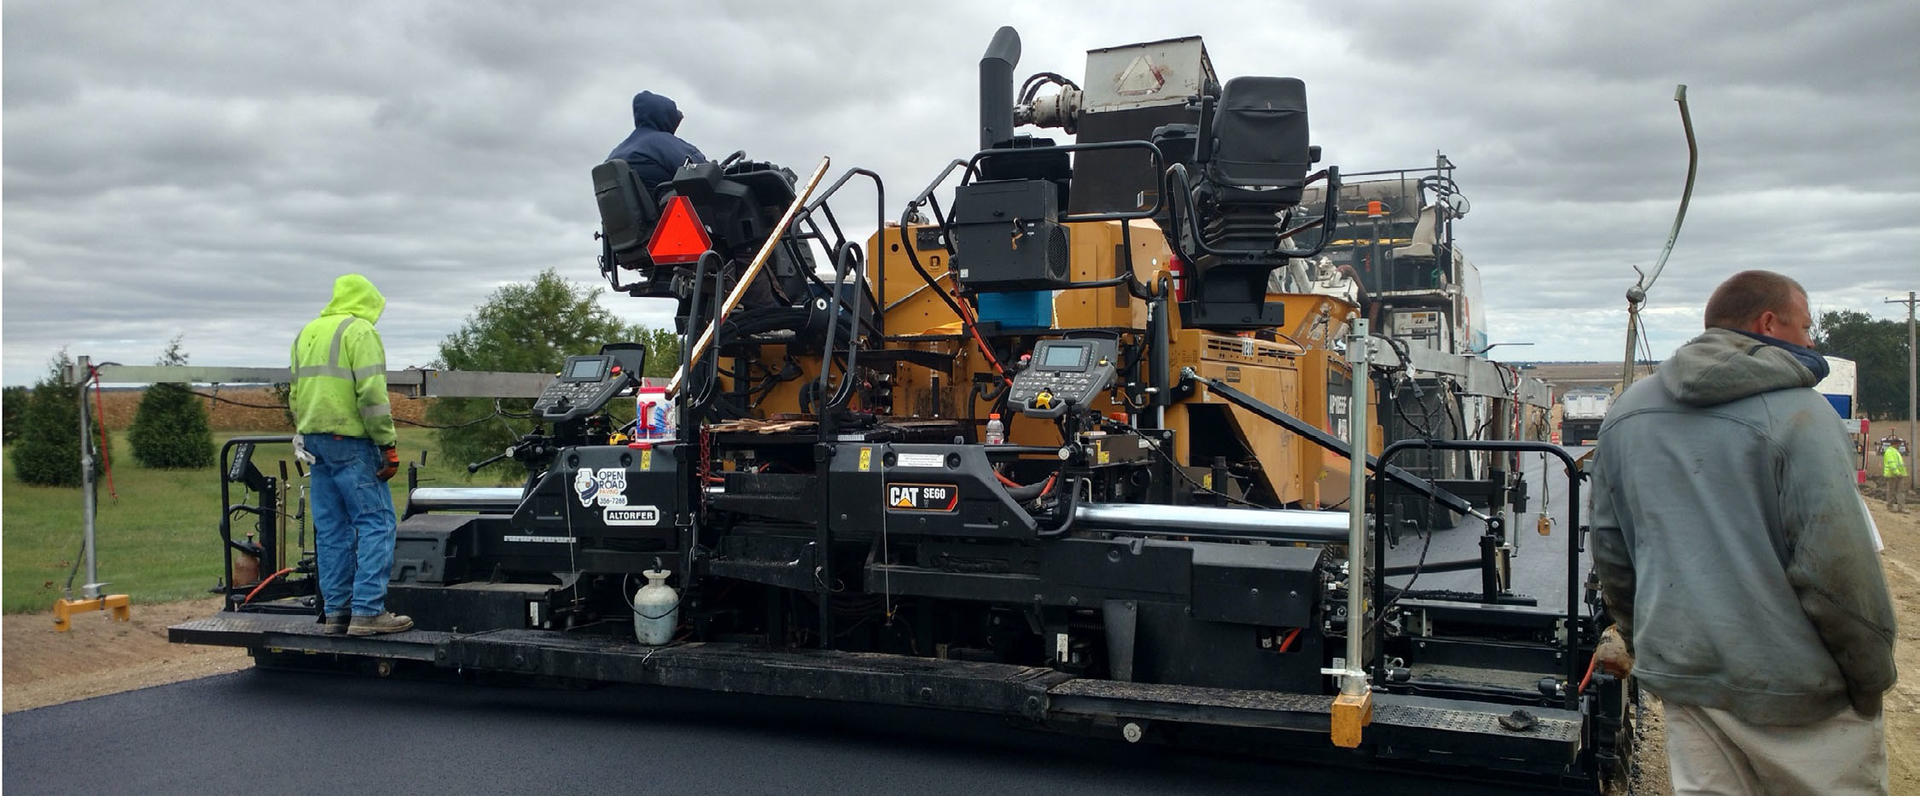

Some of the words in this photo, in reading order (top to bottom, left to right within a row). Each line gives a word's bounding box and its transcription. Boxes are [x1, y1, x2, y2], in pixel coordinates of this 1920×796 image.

[599, 471, 624, 480] OPEN
[599, 480, 625, 489] ROAD
[890, 487, 919, 507] CAT
[923, 487, 946, 500] SE60
[609, 511, 653, 520] ALTORFER
